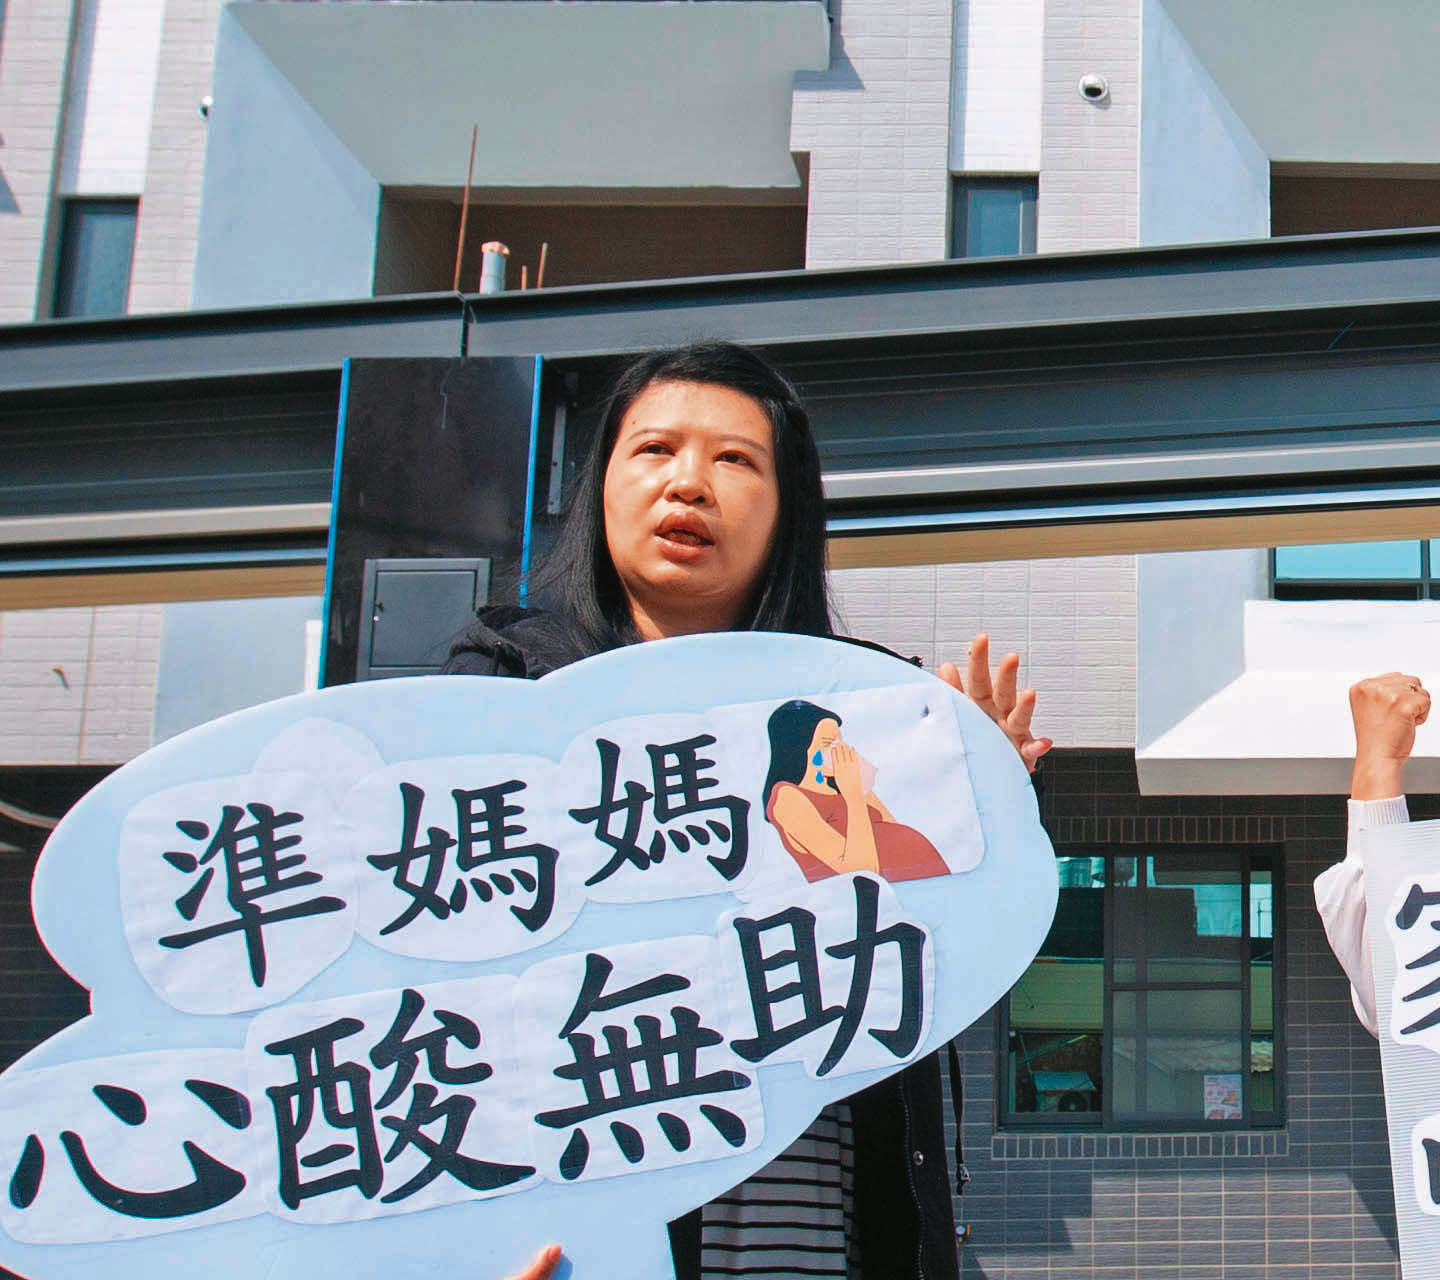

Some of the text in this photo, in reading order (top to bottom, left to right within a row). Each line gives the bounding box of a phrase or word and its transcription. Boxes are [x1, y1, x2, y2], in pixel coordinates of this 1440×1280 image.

[158, 734, 751, 988] 準媽媽
[9, 876, 925, 1219] 心酸無助
